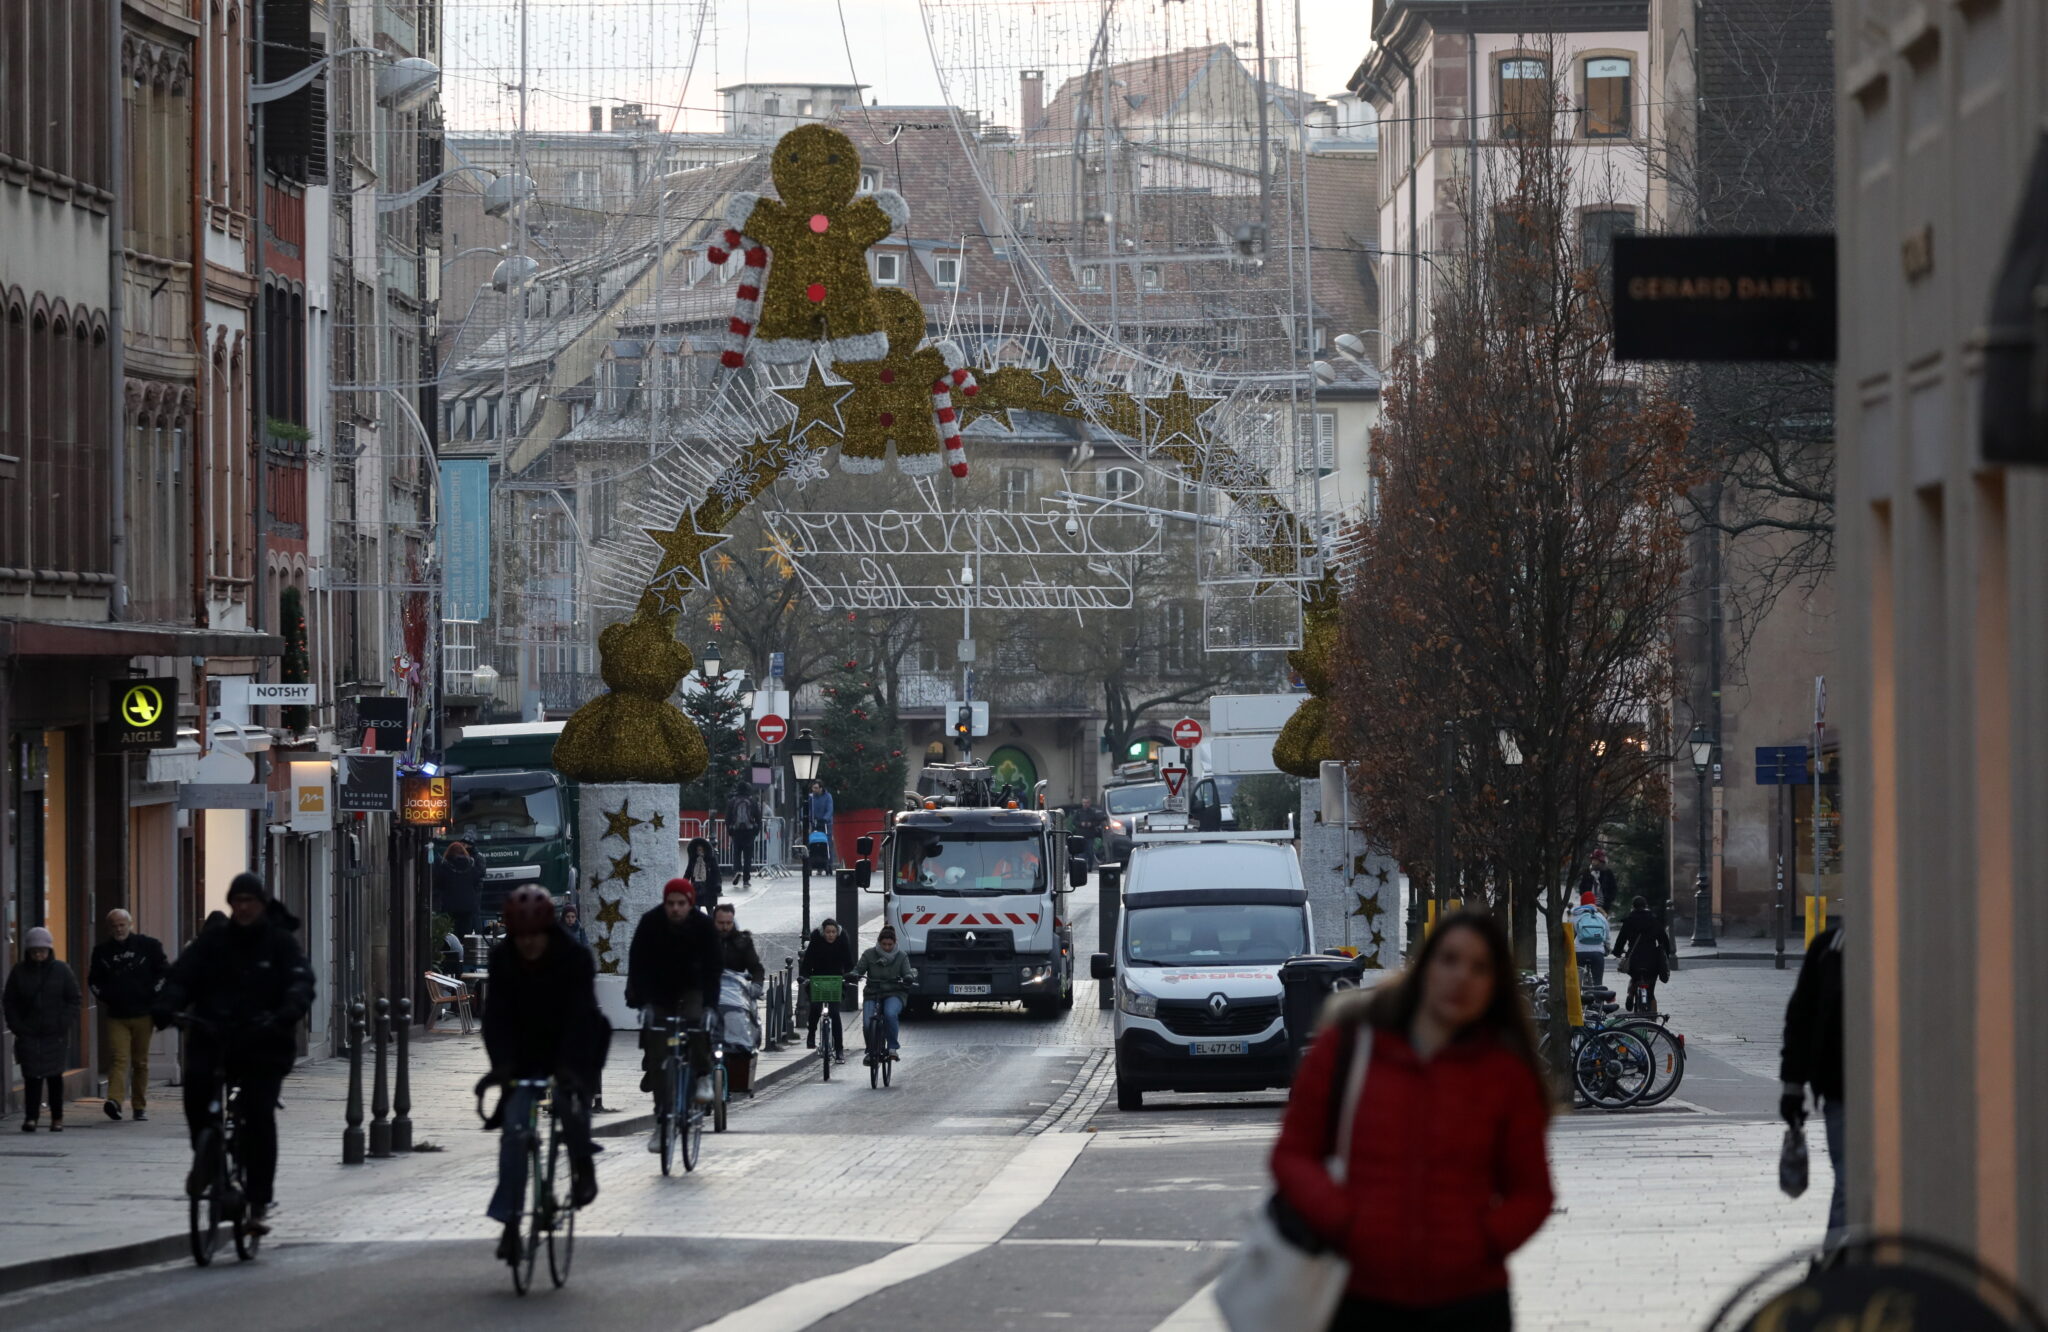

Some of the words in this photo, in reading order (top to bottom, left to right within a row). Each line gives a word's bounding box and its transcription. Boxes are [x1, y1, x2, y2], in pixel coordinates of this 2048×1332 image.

[257, 687, 309, 697] NOTSHY
[359, 719, 403, 728] GEOX
[120, 730, 163, 743] AIGLE
[404, 797, 448, 809] Jacques
[405, 807, 447, 819] Bockel
[916, 905, 926, 913] 50
